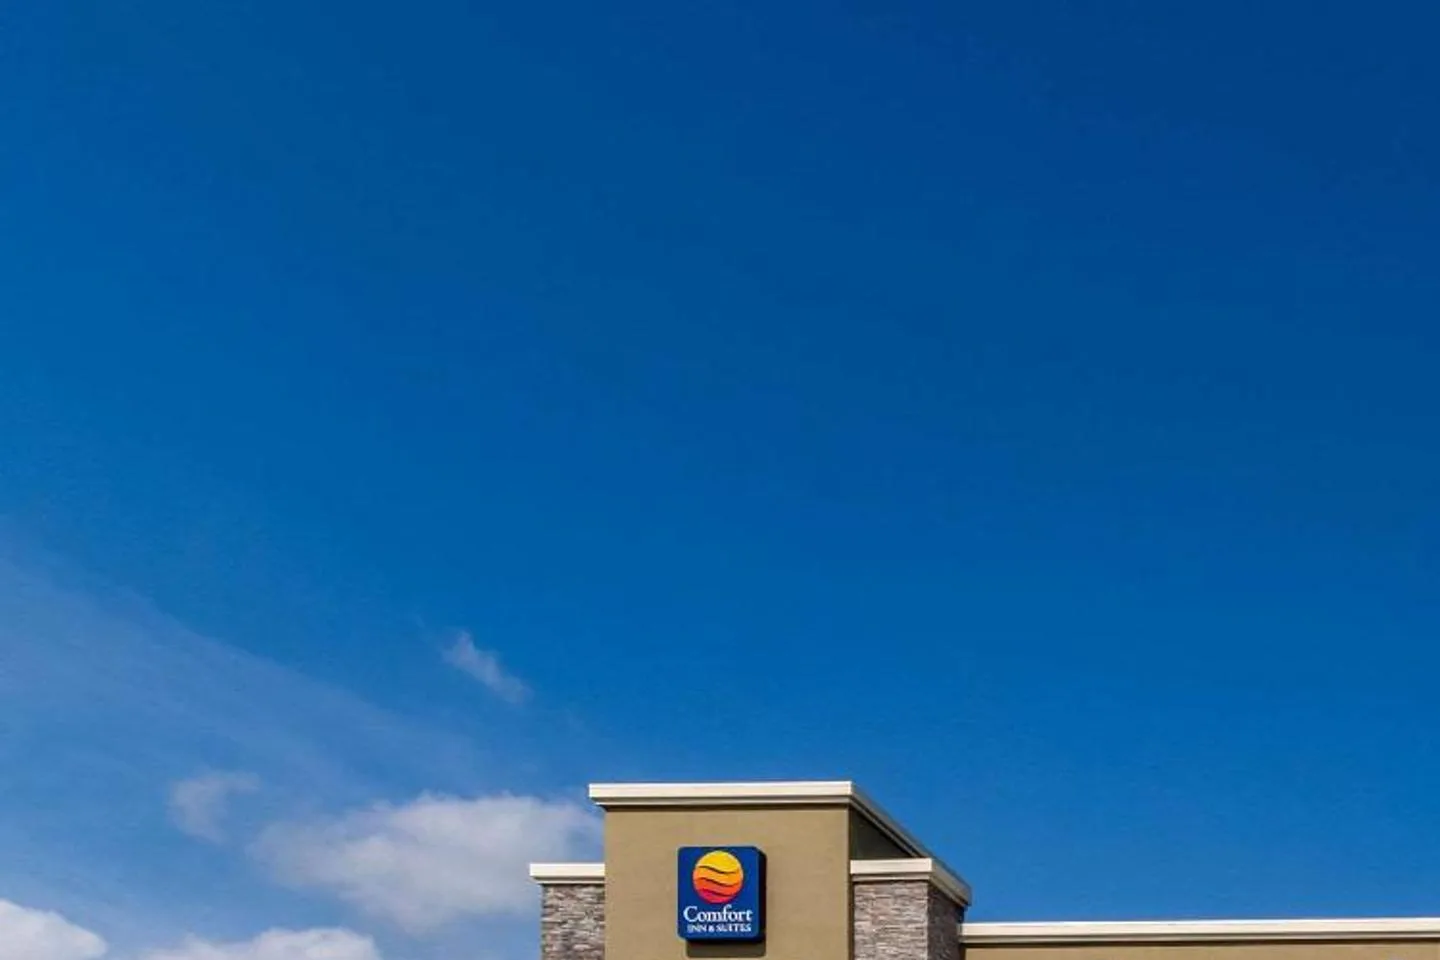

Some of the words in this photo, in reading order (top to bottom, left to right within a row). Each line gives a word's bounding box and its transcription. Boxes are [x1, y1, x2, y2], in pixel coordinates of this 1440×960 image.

[683, 904, 753, 922] Comfort
[687, 924, 707, 932] INN
[716, 923, 752, 932] SUITES
